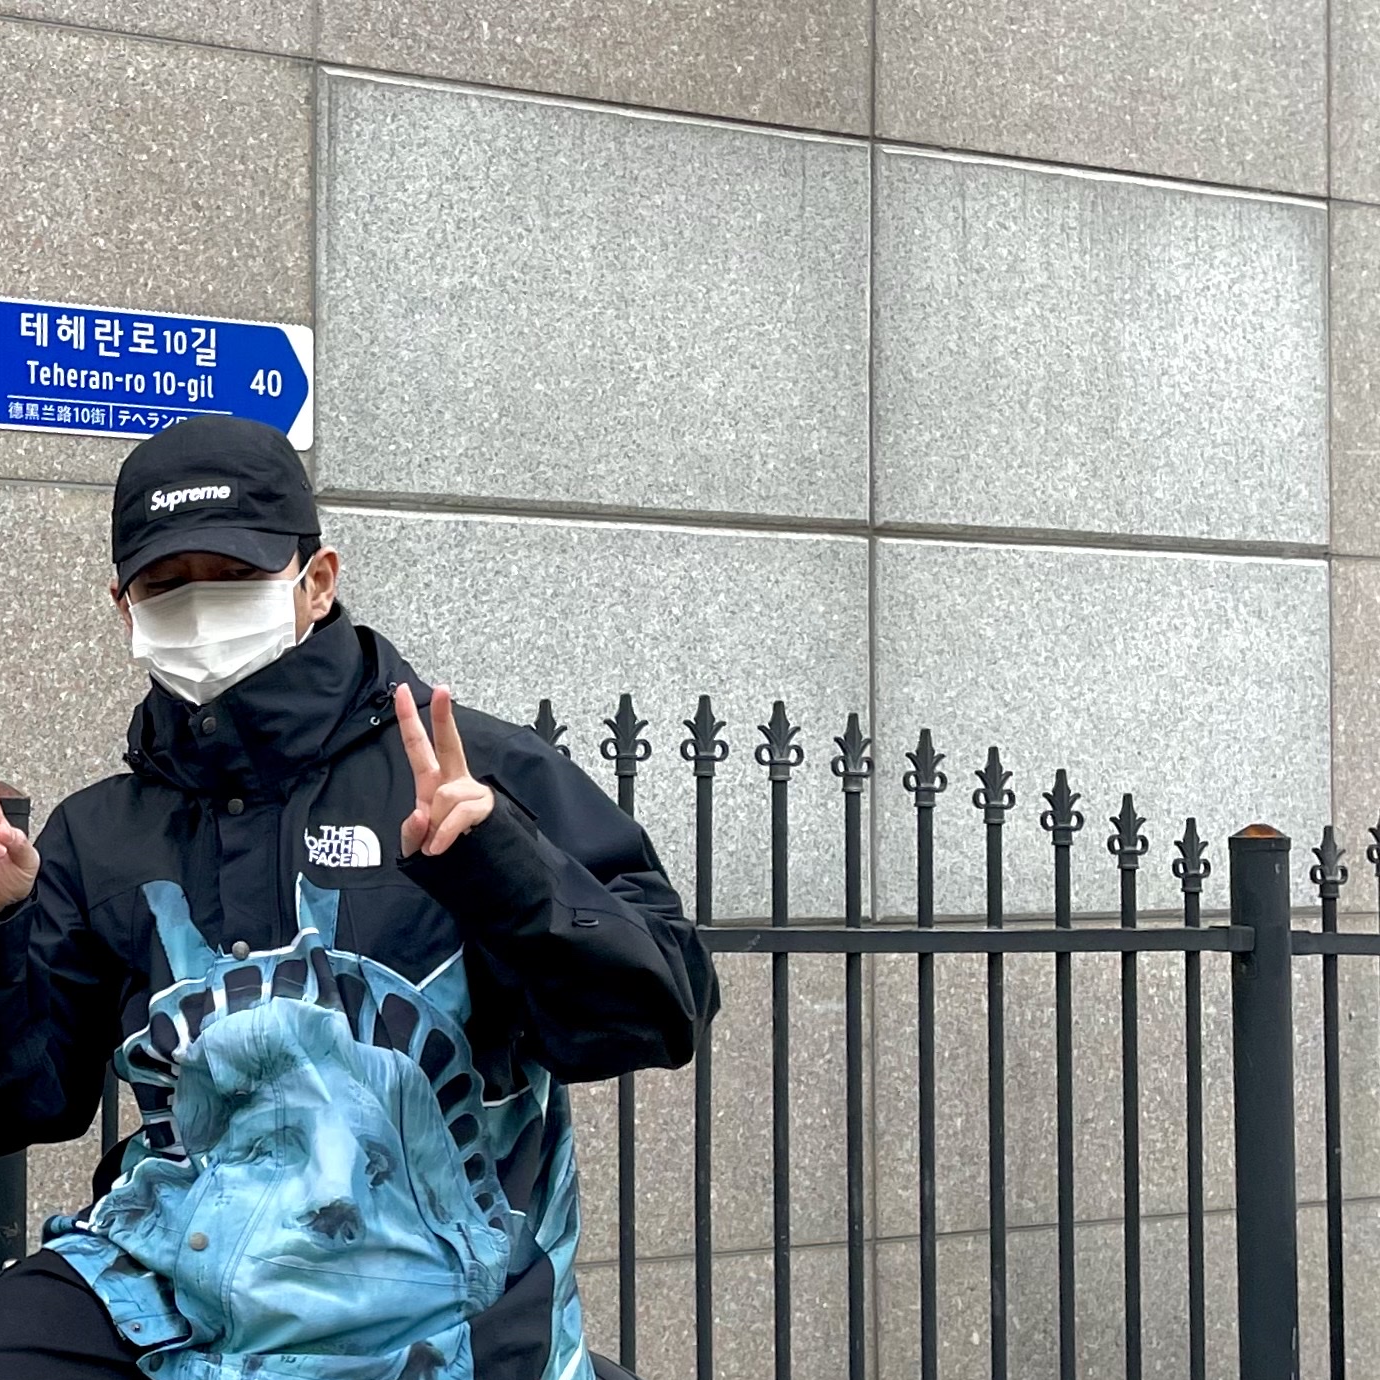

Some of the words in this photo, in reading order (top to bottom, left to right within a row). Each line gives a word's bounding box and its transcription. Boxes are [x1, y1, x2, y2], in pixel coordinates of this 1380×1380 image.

[20, 312, 217, 367] 테헤란로10길
[26, 360, 146, 394] Teheran-ro
[152, 371, 214, 402] 10-gil
[249, 369, 282, 397] 40
[118, 410, 187, 429] テヘラン
[150, 485, 231, 512] Supreme
[304, 829, 352, 854] ORTH
[319, 825, 353, 841] THE
[309, 849, 352, 868] FACE
